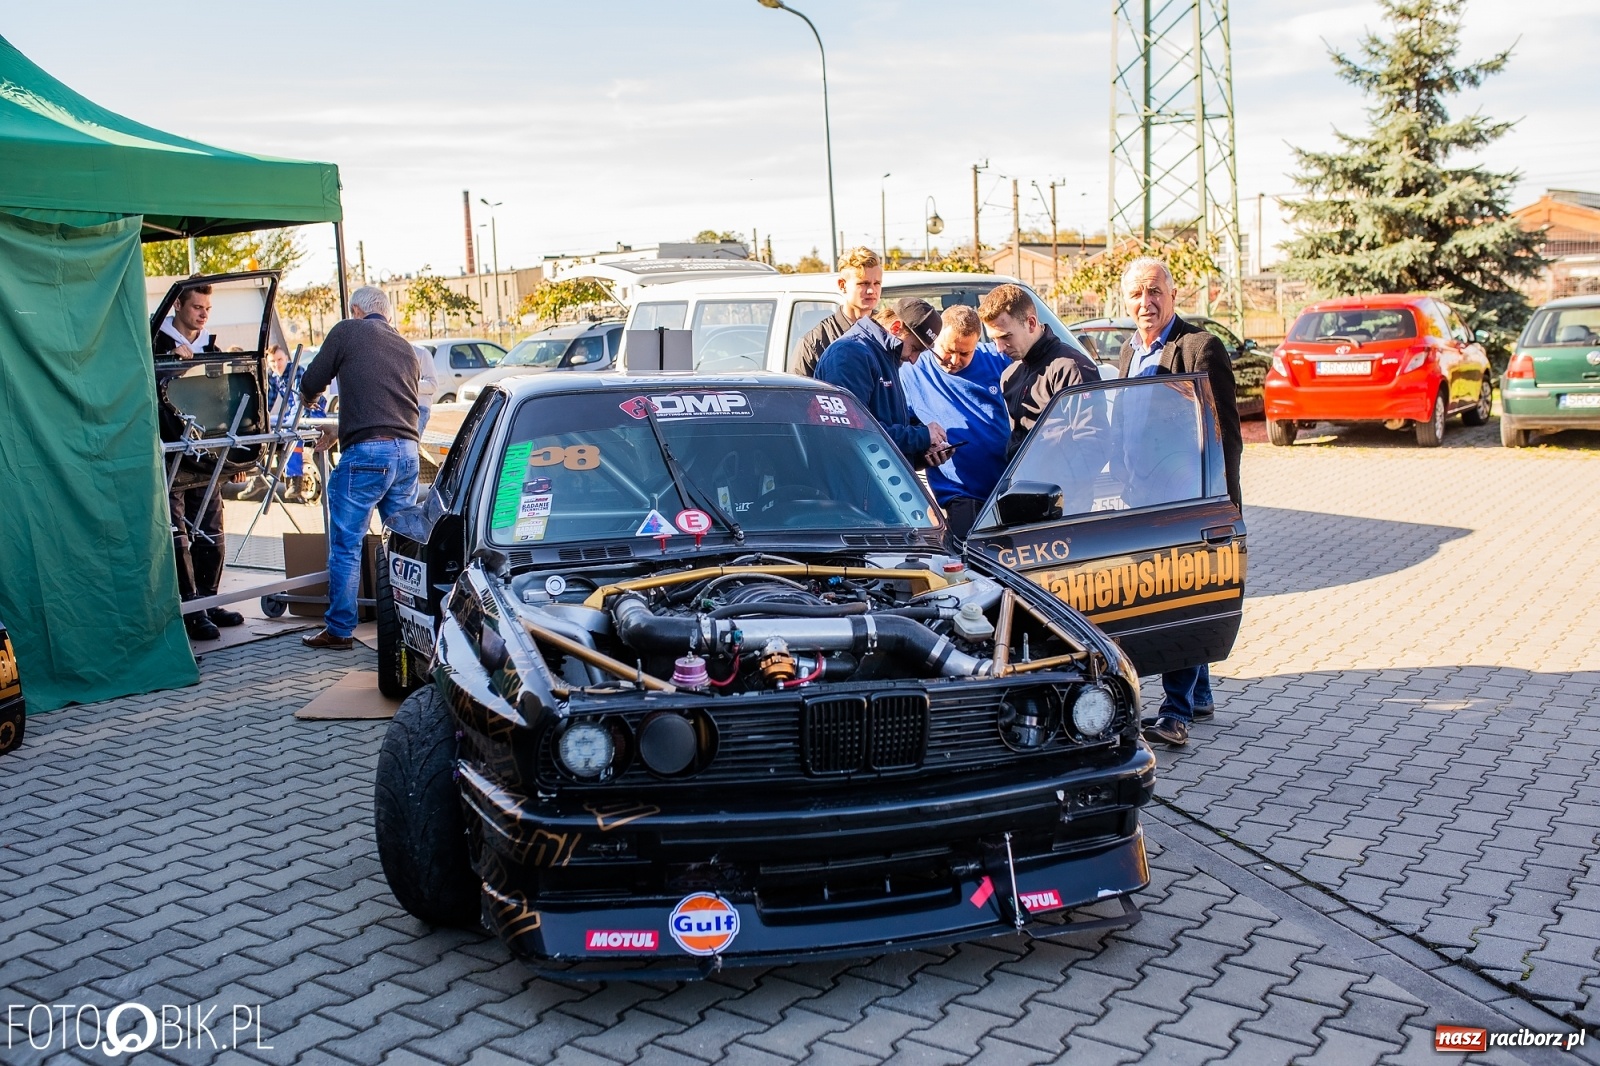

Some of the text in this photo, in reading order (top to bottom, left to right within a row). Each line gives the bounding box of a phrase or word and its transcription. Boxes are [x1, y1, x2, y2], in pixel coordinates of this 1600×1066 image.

[651, 395, 747, 413] DMP
[815, 395, 847, 412] 58
[819, 415, 851, 425] PRO
[522, 502, 550, 510] BADANIE
[685, 514, 702, 528] E
[997, 539, 1070, 568] GEKO
[1020, 892, 1059, 908] OTUL
[673, 915, 734, 932] Gulf
[590, 932, 655, 947] MOTUL
